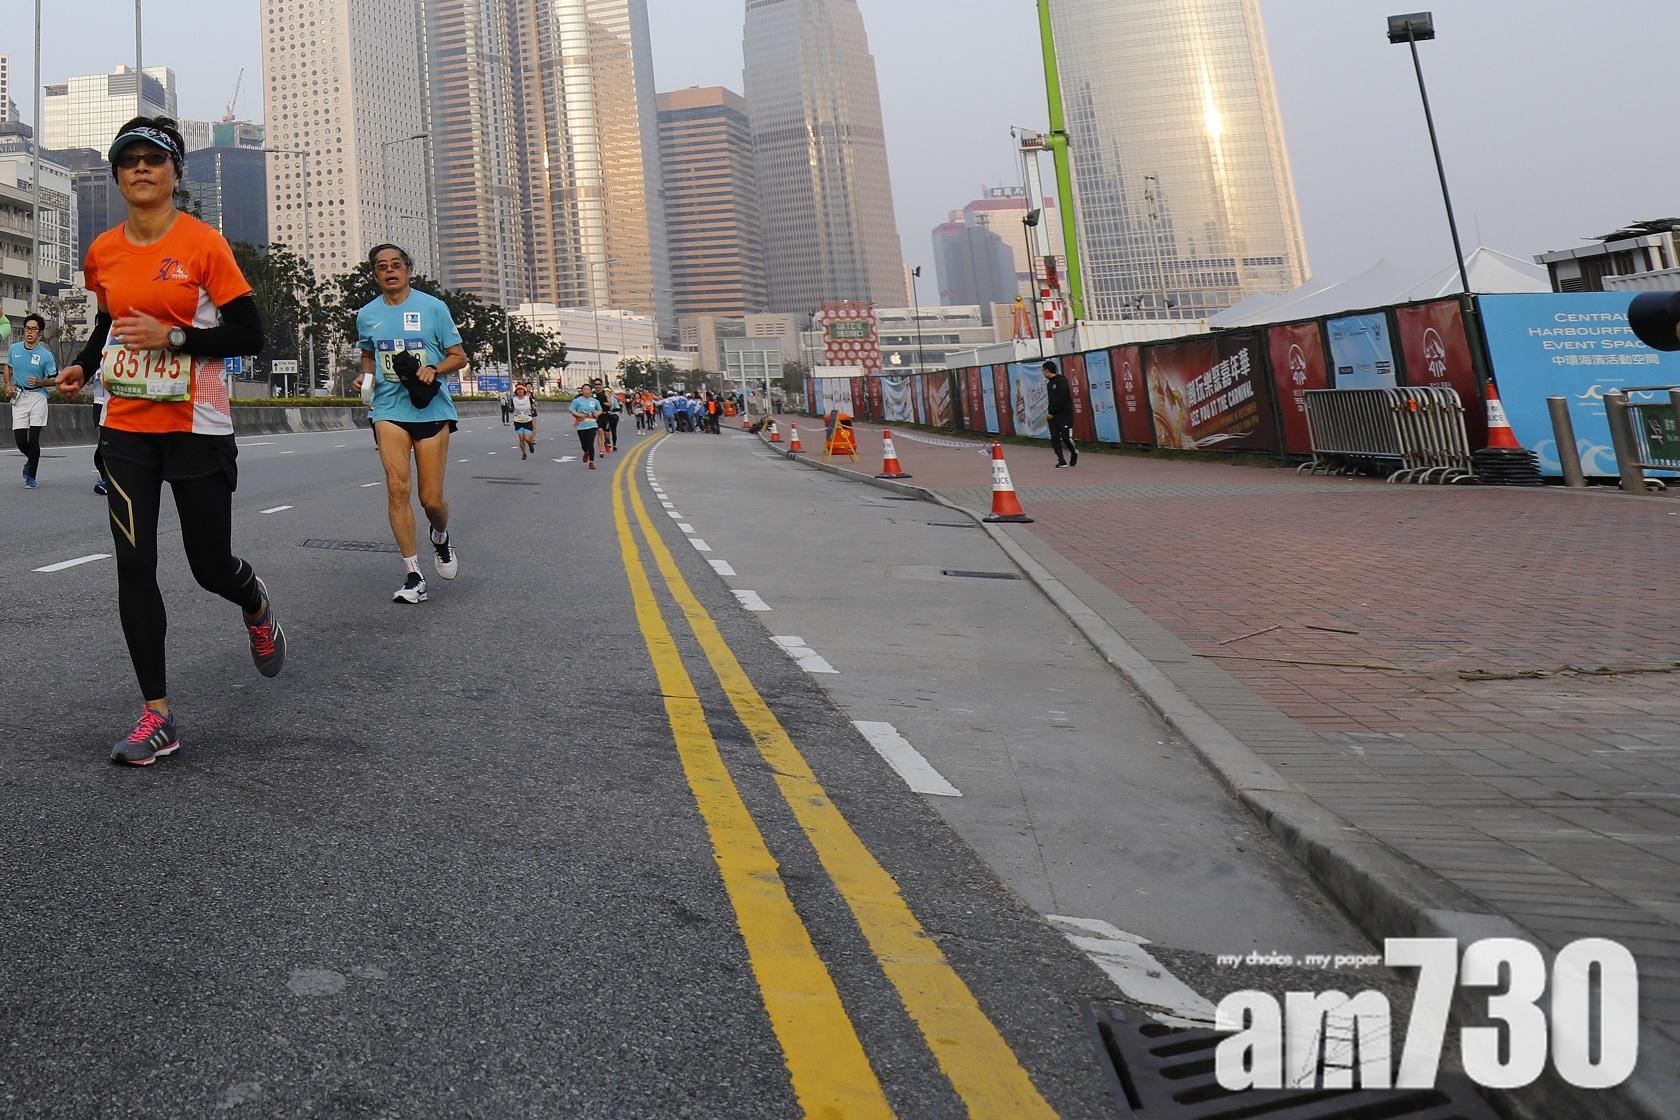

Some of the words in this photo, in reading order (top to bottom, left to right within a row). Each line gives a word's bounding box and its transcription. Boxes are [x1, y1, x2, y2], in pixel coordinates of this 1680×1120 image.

[1553, 312, 1630, 323] CENTRAL
[1528, 327, 1635, 337] HARBOURFR
[1542, 339, 1597, 350] EVENT
[1601, 339, 1647, 350] SPAC
[113, 349, 181, 380] 85145
